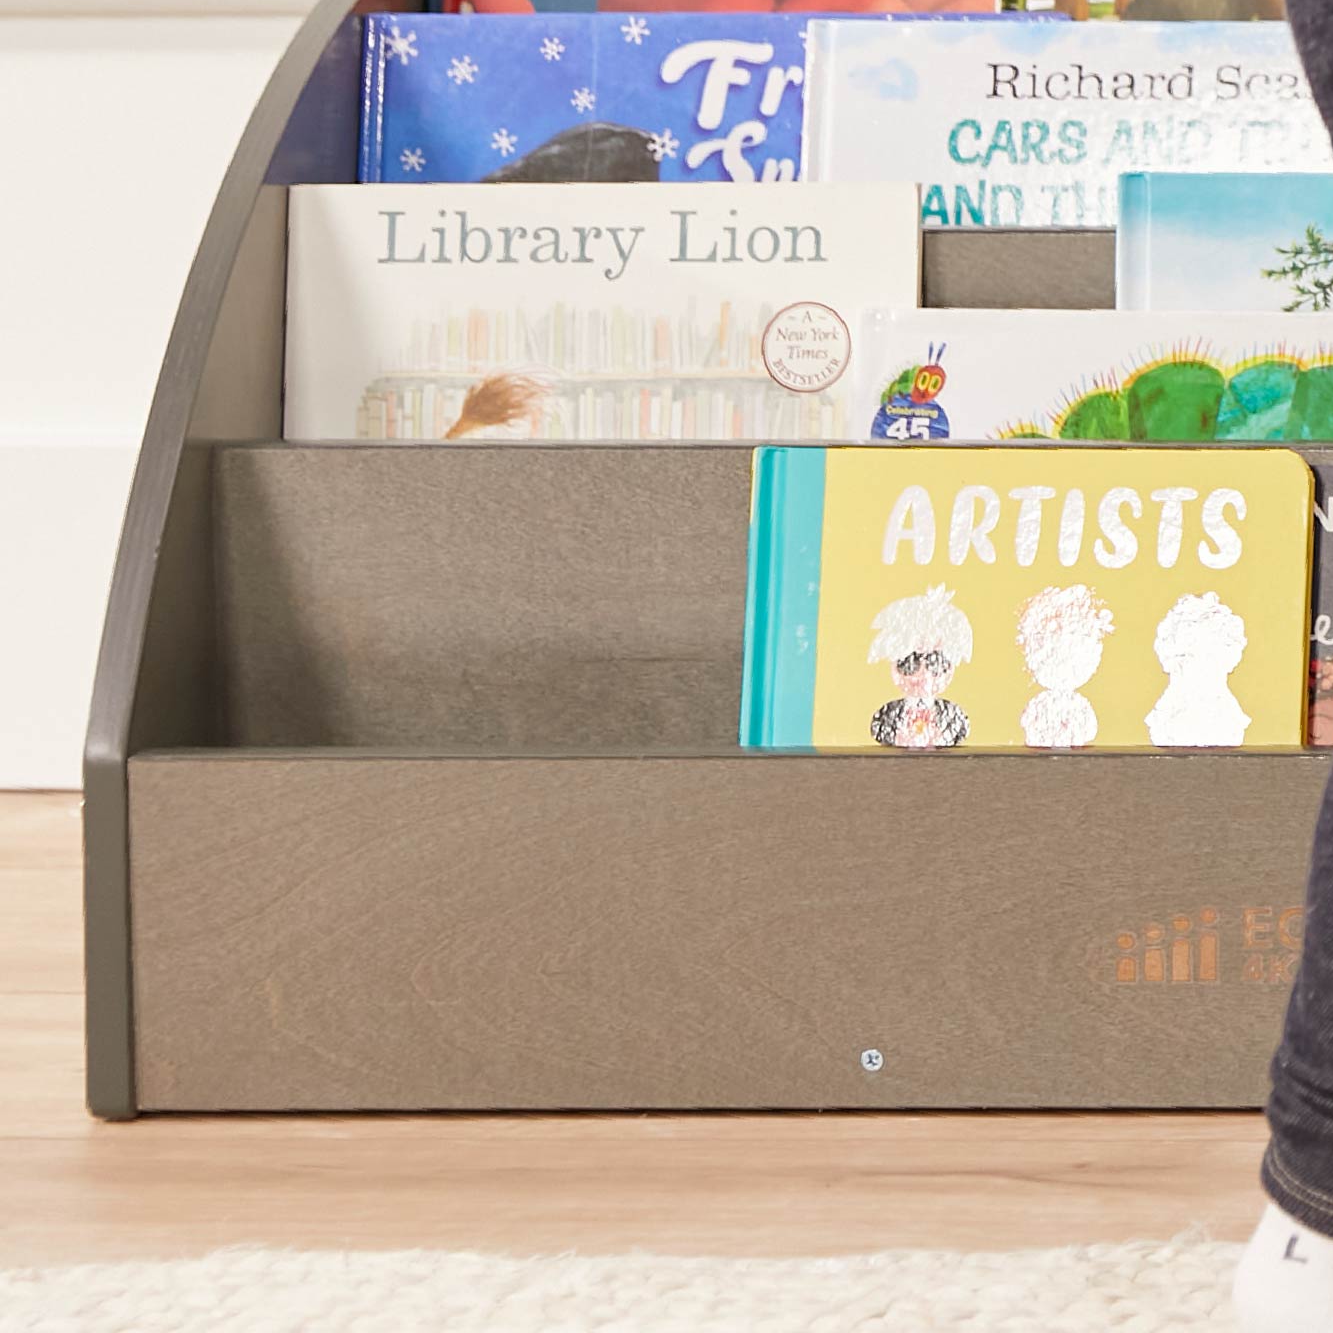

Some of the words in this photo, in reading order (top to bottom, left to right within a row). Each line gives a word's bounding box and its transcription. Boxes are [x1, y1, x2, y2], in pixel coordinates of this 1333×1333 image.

[985, 62, 1194, 101] Richard
[947, 118, 1088, 167] CARS
[377, 209, 645, 280] Library
[668, 209, 827, 264] Lion
[787, 344, 829, 359] Times
[811, 324, 839, 341] York
[886, 416, 930, 440] 45
[881, 485, 1247, 569] ARTISTS
